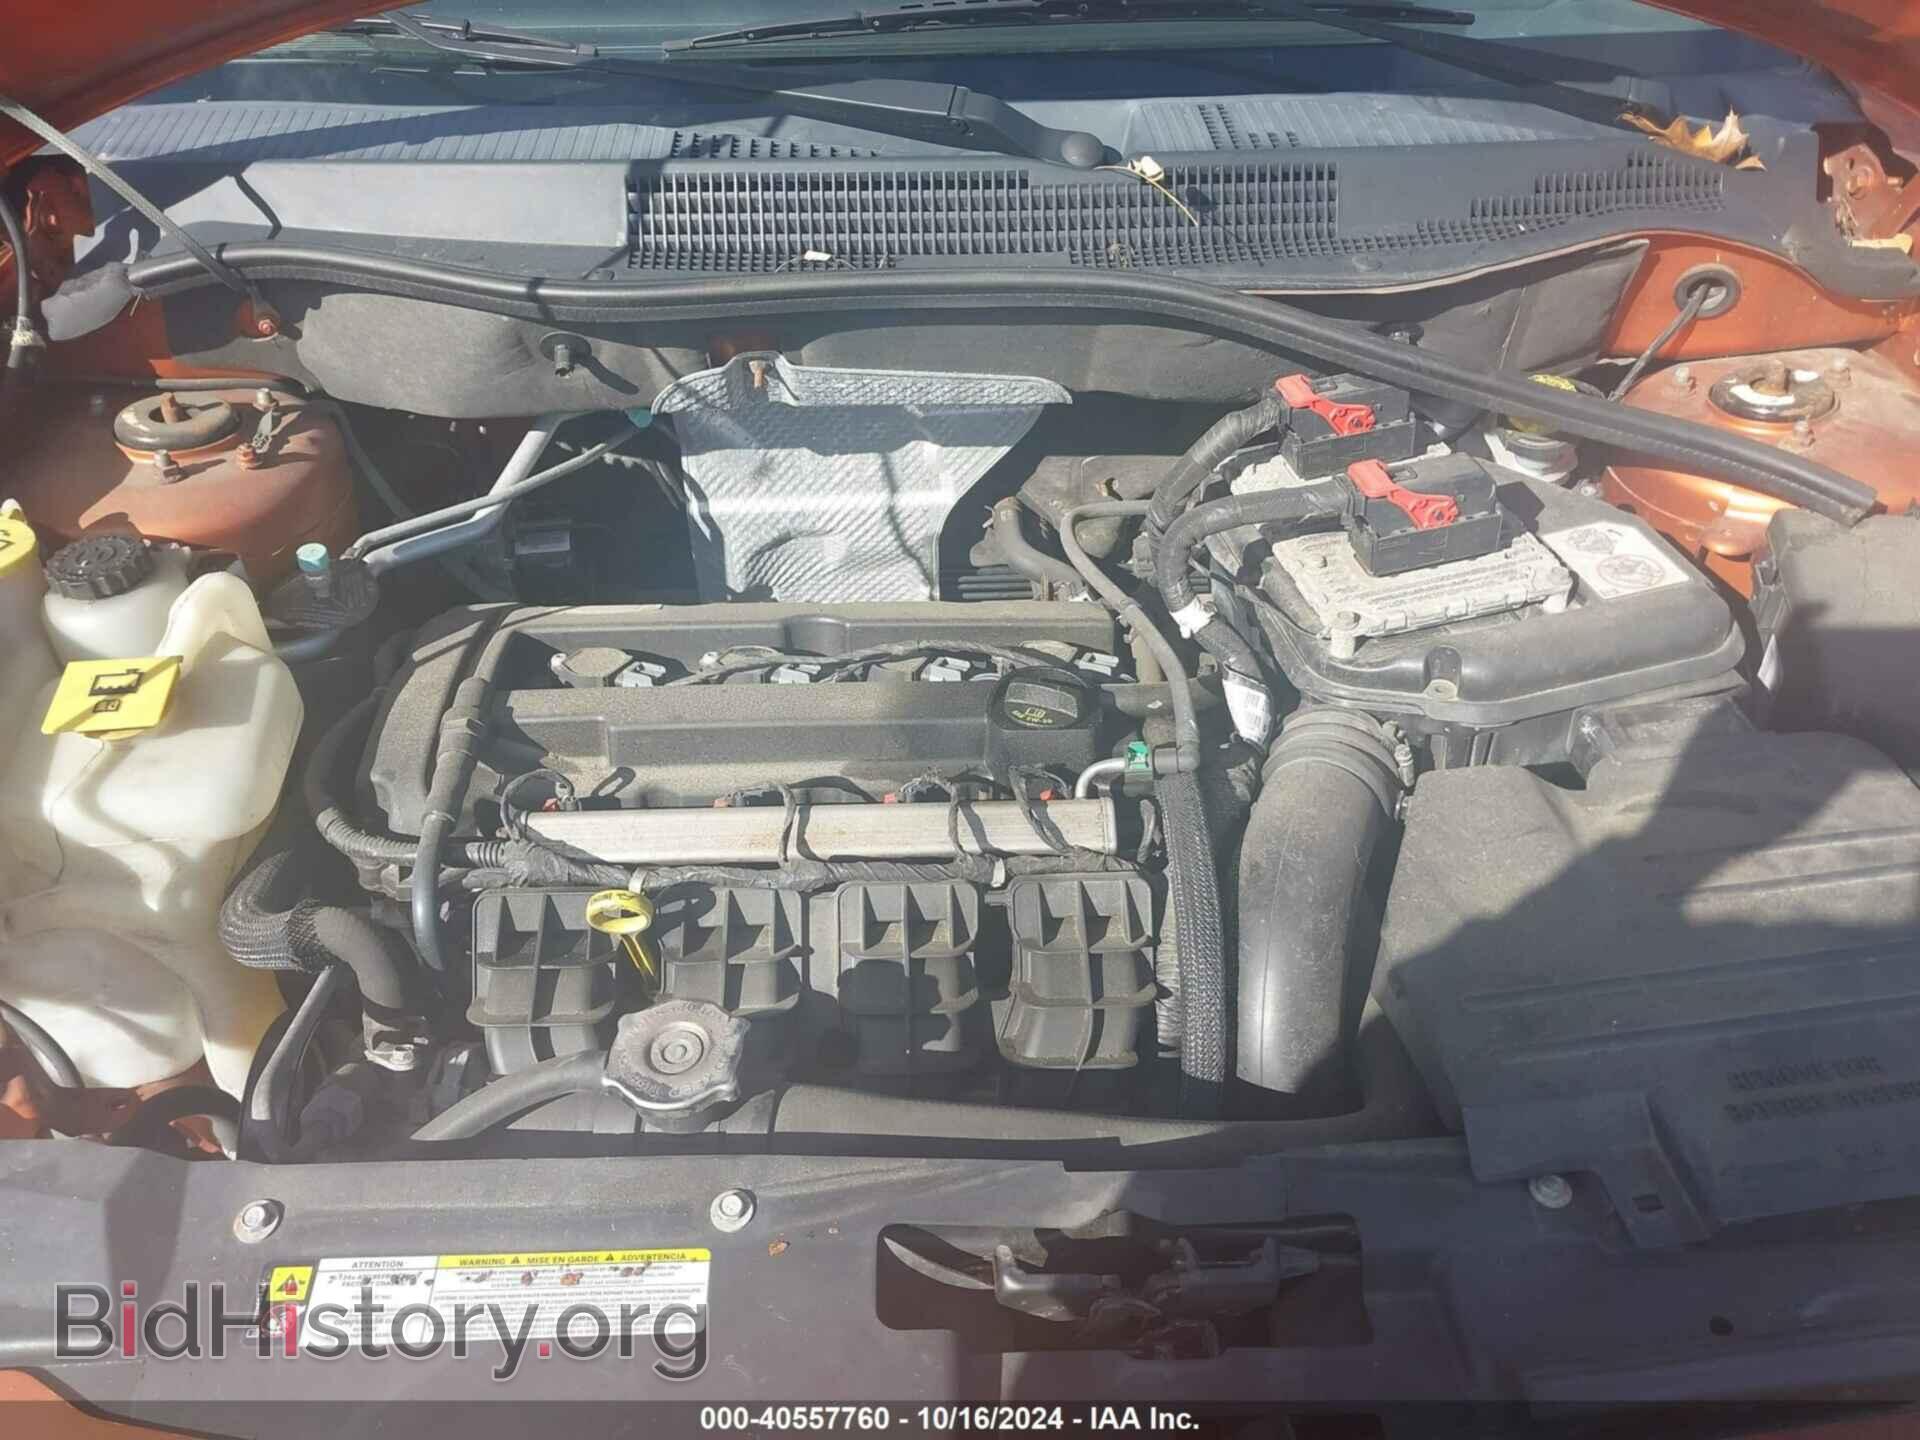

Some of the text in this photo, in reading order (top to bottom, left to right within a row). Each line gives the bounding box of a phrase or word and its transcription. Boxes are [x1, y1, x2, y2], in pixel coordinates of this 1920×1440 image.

[351, 1260, 404, 1269] ATTENTION
[459, 1251, 686, 1266] WARNING MISE EN GARDE ADVERTENCIA
